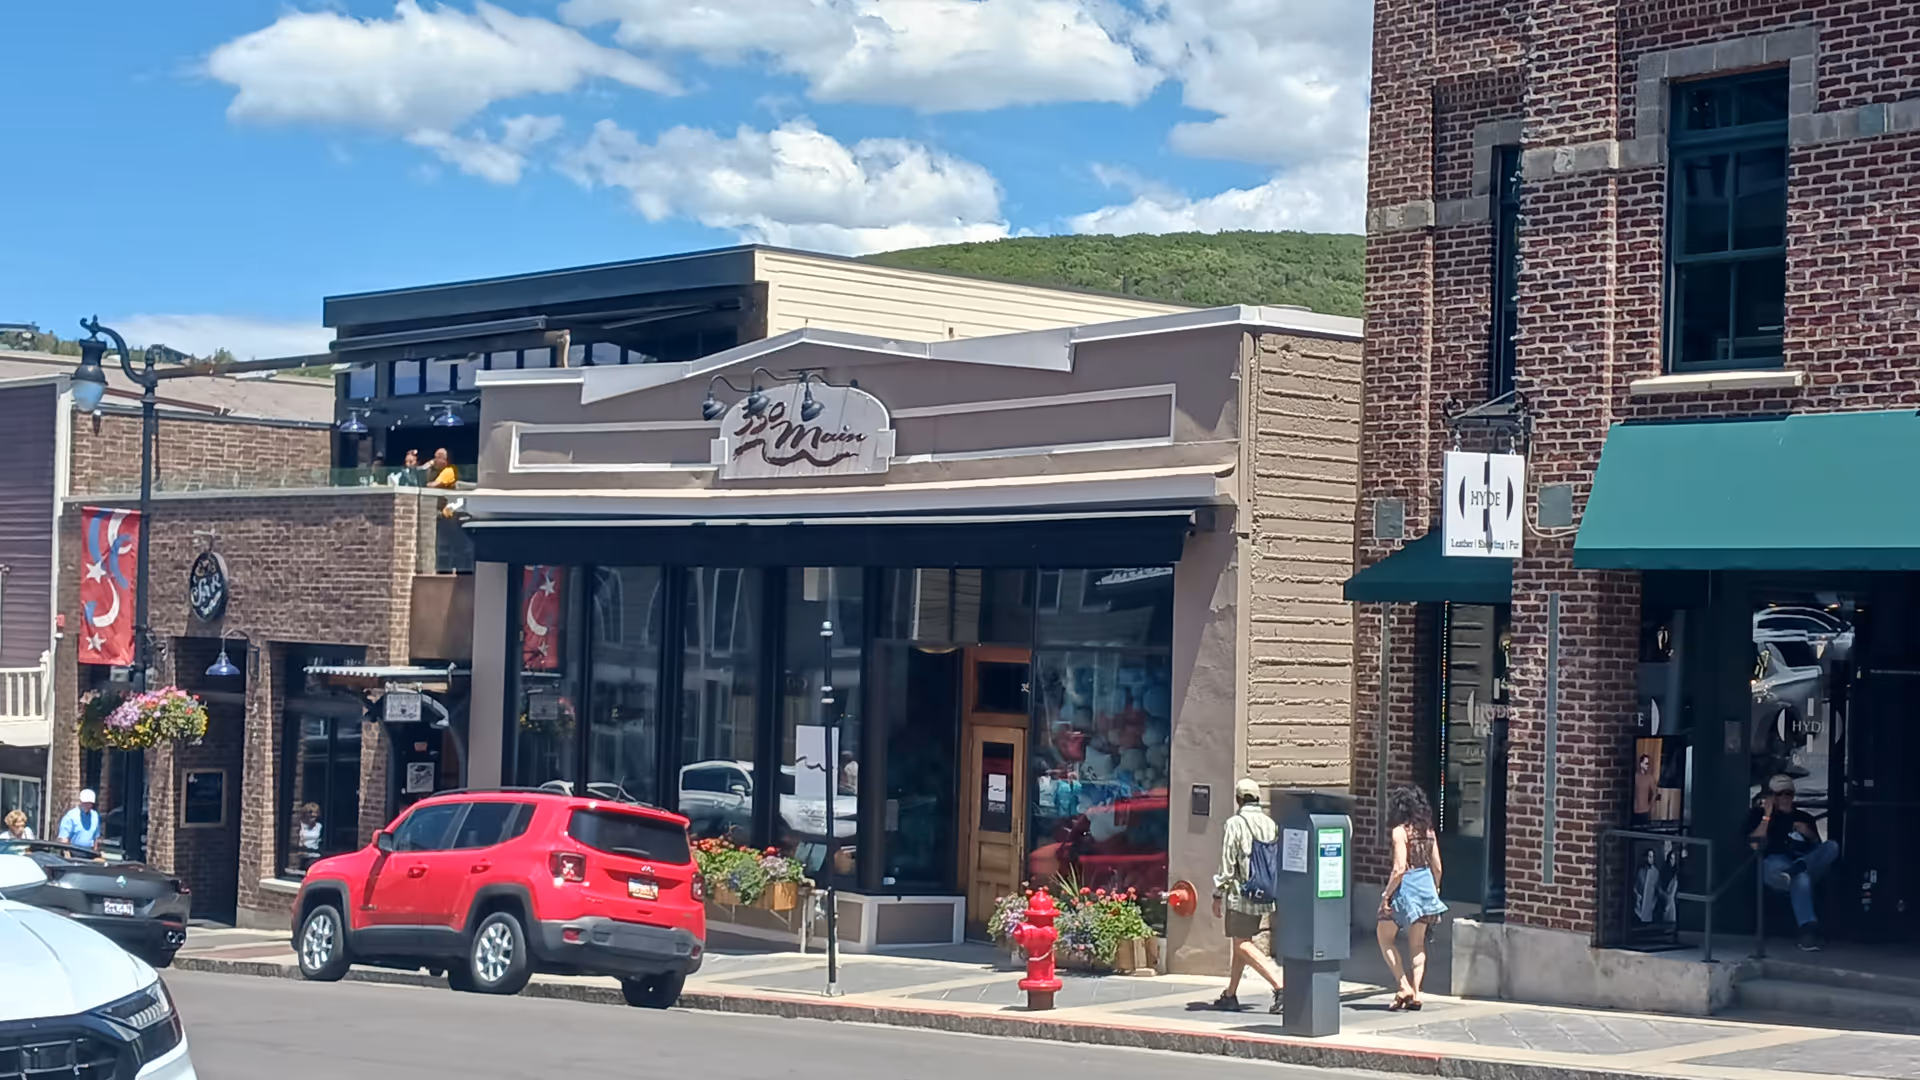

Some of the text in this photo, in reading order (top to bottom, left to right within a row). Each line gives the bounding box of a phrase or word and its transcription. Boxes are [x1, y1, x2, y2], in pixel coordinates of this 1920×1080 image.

[769, 419, 868, 450] Main
[1470, 490, 1501, 507] HYDE
[1450, 538, 1520, 550] Leather Shling Fur
